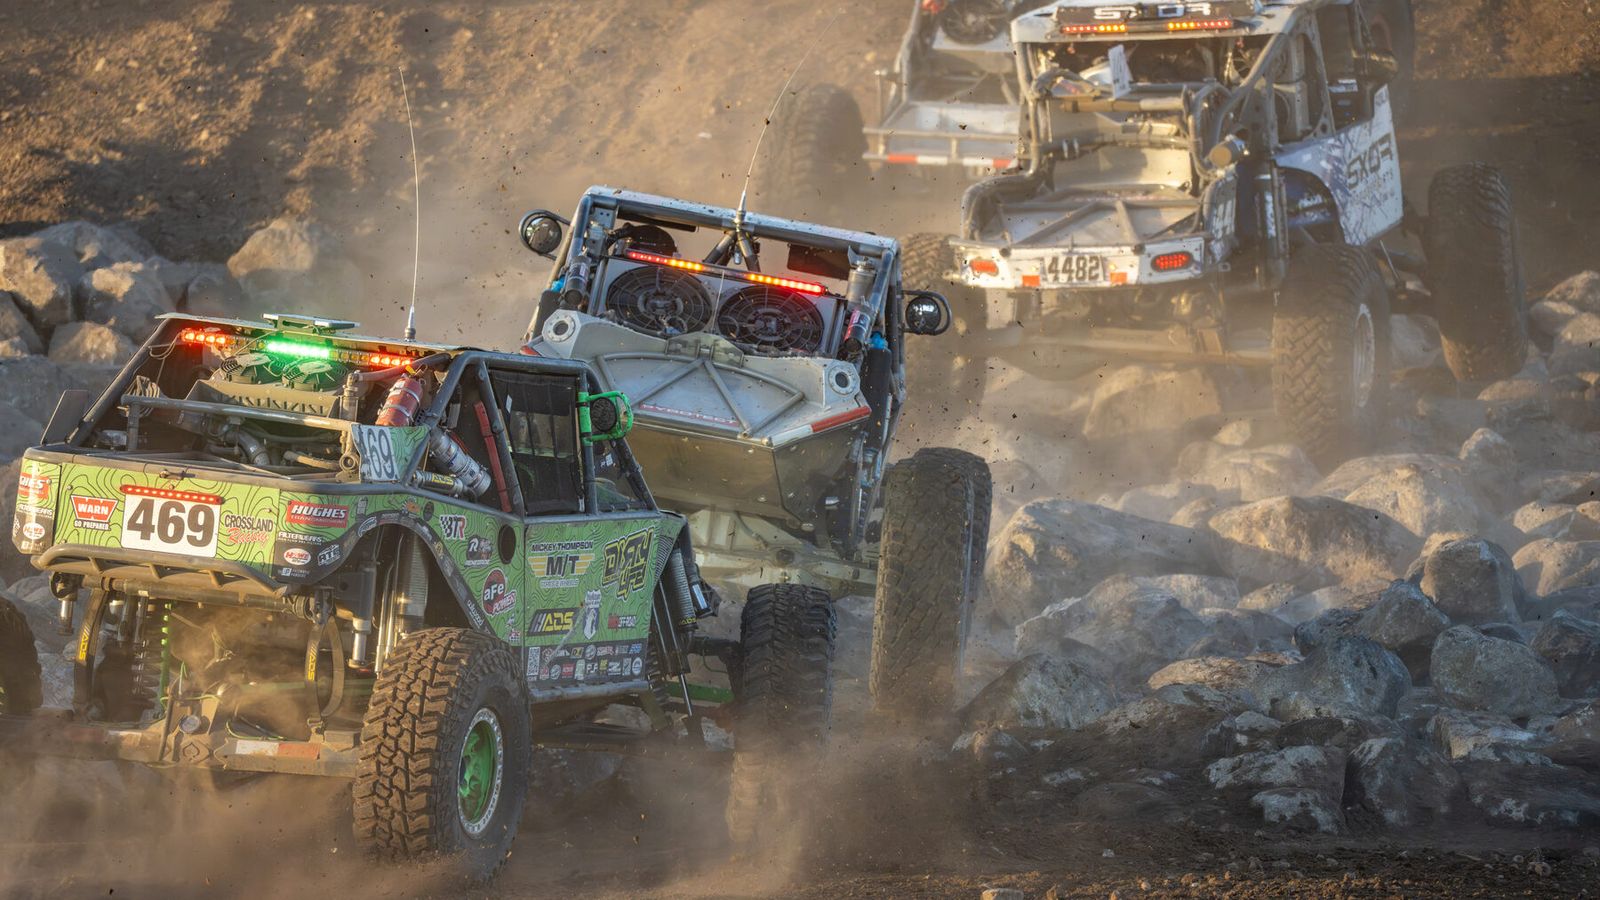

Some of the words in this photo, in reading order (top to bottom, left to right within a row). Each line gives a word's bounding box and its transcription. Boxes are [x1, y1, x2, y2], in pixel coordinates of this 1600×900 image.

[1047, 255, 1100, 281] 4482
[77, 503, 109, 515] WARN
[291, 504, 347, 519] HUGHES
[126, 498, 215, 548] 469
[224, 514, 274, 532] CROSSLAND
[227, 527, 268, 549] Racing
[558, 541, 594, 551] THOMPSON
[545, 553, 580, 577] M/T
[483, 583, 505, 601] aFe
[542, 611, 575, 633] ADS
[79, 632, 89, 661] ADS
[307, 653, 317, 681] ADS
